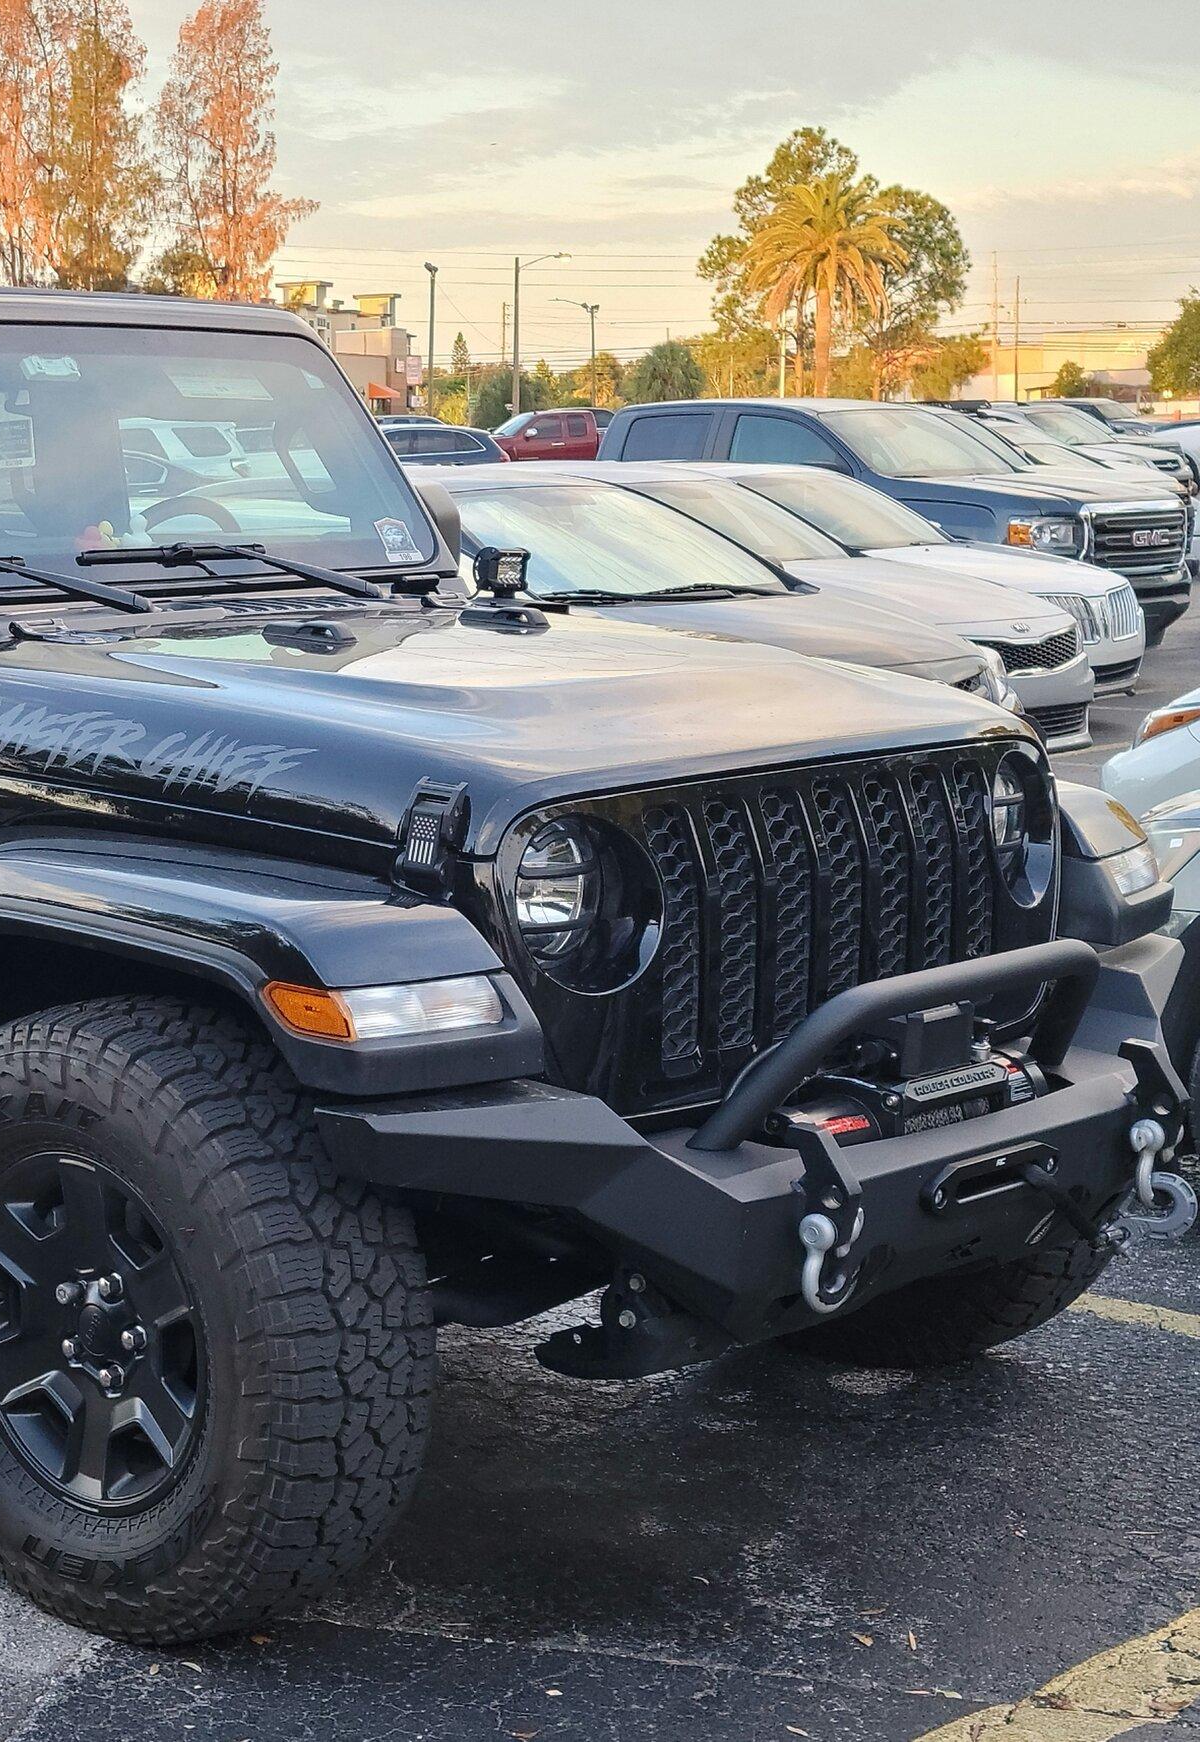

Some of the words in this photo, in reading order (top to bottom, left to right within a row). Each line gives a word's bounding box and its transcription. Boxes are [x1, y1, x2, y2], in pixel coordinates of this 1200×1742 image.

[1132, 529, 1171, 547] GMC
[139, 728, 319, 803] CHIEF
[914, 1079, 950, 1097] ROUGH
[952, 1067, 997, 1087] COUNTRY
